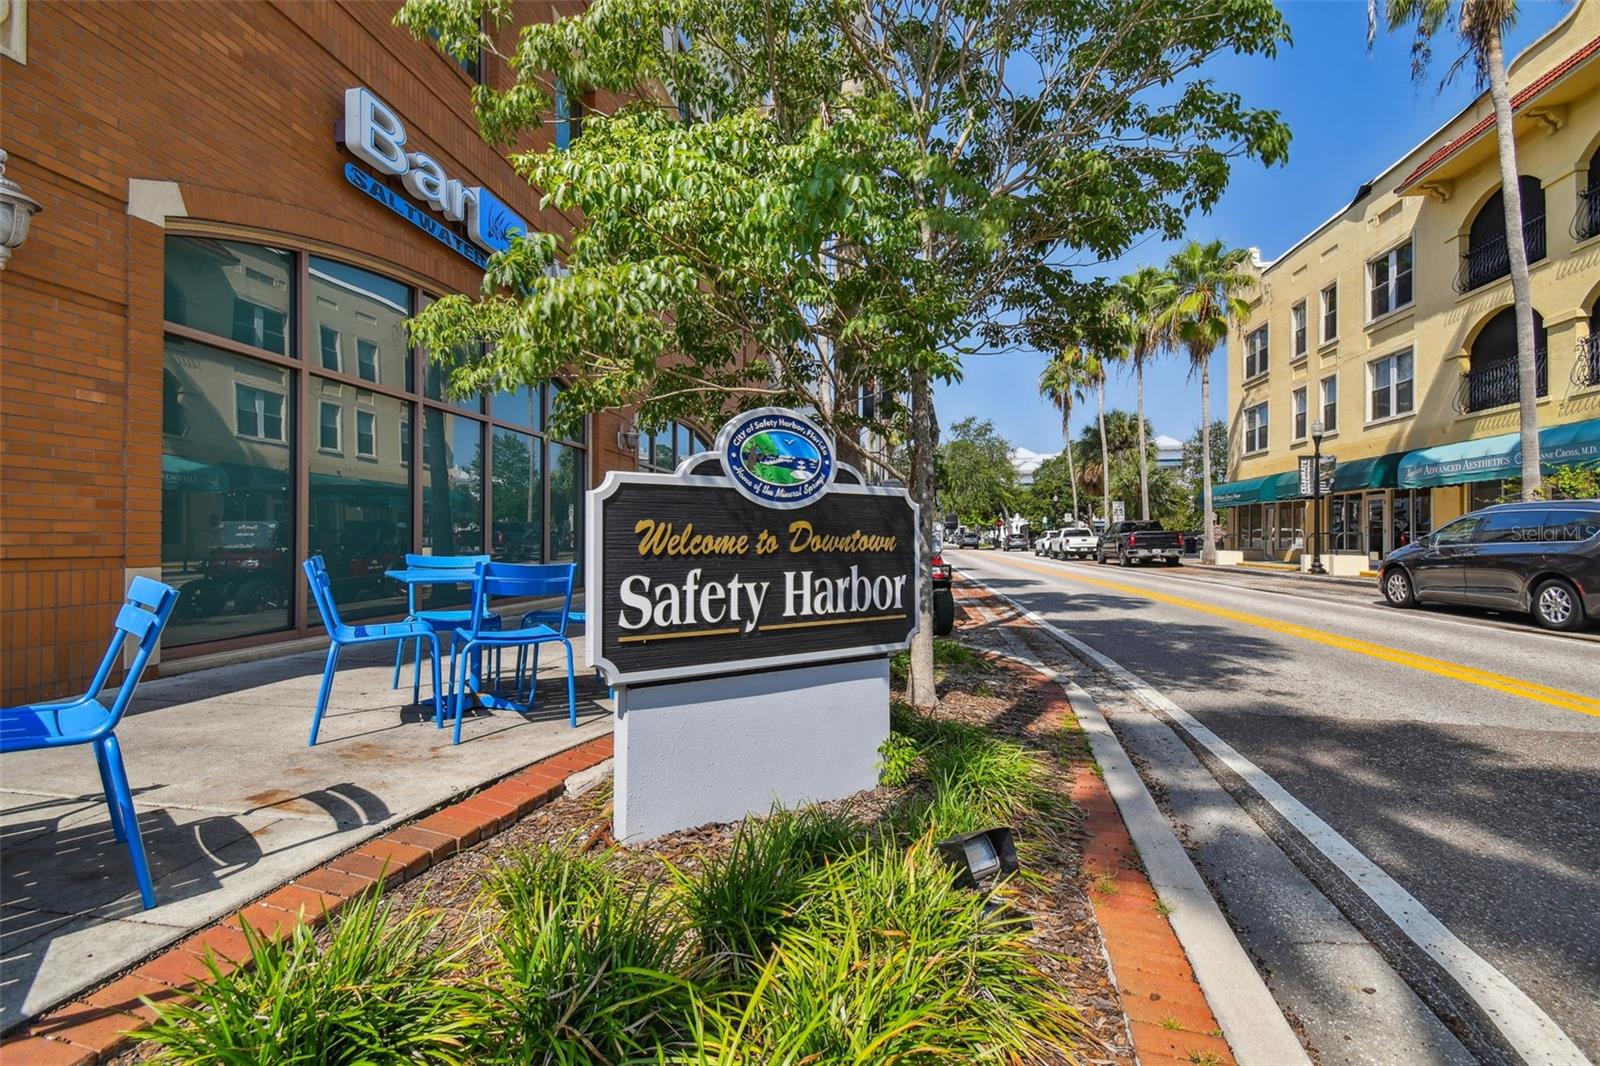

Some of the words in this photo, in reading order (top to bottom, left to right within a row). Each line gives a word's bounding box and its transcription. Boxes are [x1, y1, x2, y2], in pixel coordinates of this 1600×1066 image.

[349, 164, 488, 268] SALTWATER
[733, 430, 747, 447] City
[746, 423, 755, 434] of
[754, 419, 778, 430] Safety
[806, 429, 828, 456] Florida
[732, 465, 753, 487] Home
[753, 482, 763, 494] of
[762, 485, 774, 497] the
[634, 519, 749, 556] Welcome
[754, 529, 778, 555] to
[788, 520, 897, 553] Downtown
[618, 568, 770, 633] Safety
[782, 565, 907, 617] Harbor
